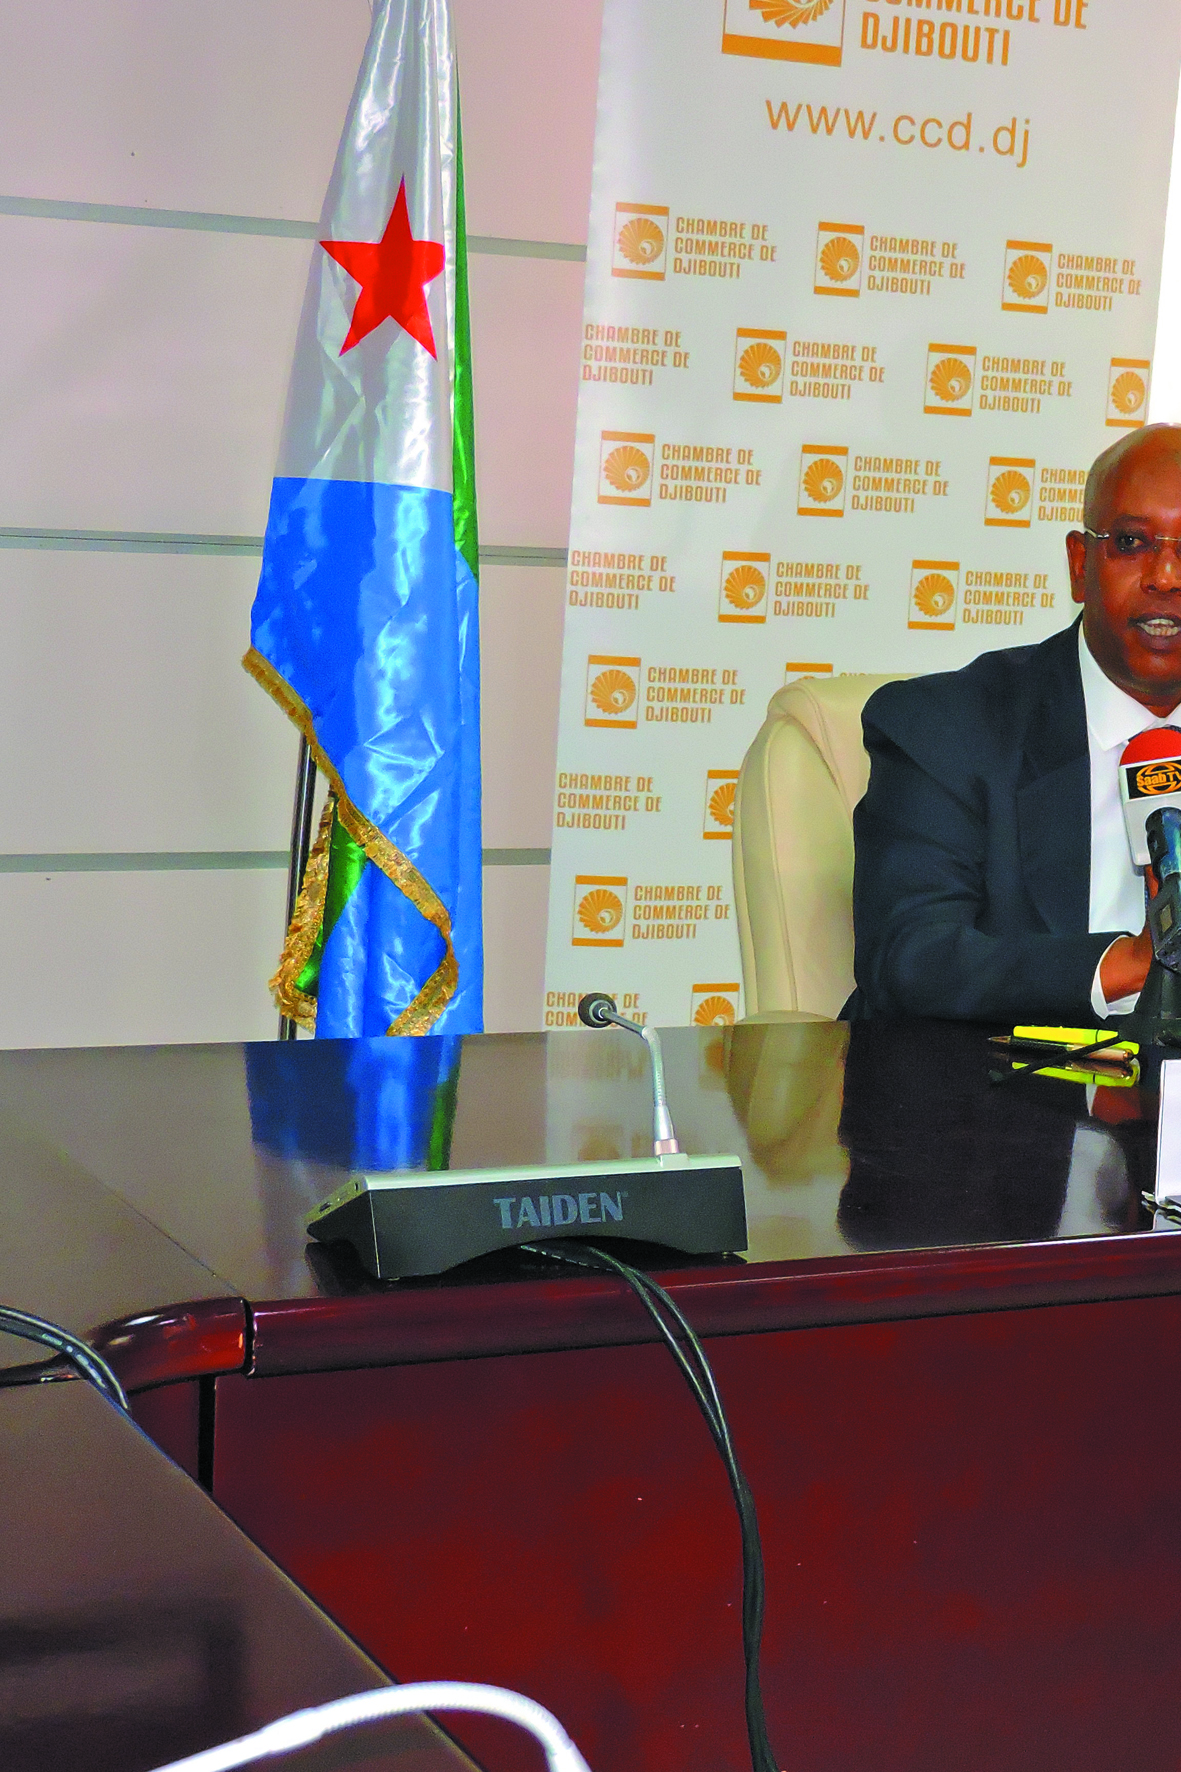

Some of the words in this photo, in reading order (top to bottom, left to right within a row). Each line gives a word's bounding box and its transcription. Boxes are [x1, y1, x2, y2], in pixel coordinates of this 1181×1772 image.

[860, 12, 1010, 66] DJIBOUTI
[765, 98, 1030, 168] www.ccd.dj
[675, 217, 746, 240] CHAMBRE
[751, 224, 767, 240] DE
[674, 236, 753, 259] COMMERCE
[759, 244, 775, 261] DE
[870, 235, 935, 258] CHAMBRE
[941, 242, 956, 257] DE
[673, 254, 740, 277] DJIBOUTI
[868, 254, 944, 277] COMMERCE
[949, 262, 964, 278] DE
[1058, 253, 1117, 274] CHAMBRE
[1122, 259, 1135, 275] DE
[867, 275, 930, 295] DJIBOUTI
[1056, 273, 1123, 293] COMMERCE
[1128, 279, 1140, 294] DE
[1055, 291, 1112, 310] DJIBOUTI
[583, 324, 658, 345] CHAMBRE
[663, 330, 680, 349] DE
[581, 343, 667, 366] COMMERCE
[672, 349, 689, 368] DE
[792, 341, 855, 361] CHAMBRE
[861, 346, 876, 363] DE
[582, 363, 653, 384] DJIBOUTI
[791, 361, 863, 381] COMMERCE
[869, 364, 884, 382] DE
[982, 356, 1045, 375] CHAMBRE
[1051, 361, 1064, 377] DE
[790, 380, 851, 399] DJIBOUTI
[981, 375, 1052, 394] COMMERCE
[1058, 381, 1071, 396] DE
[980, 394, 1040, 412] DJIBOUTI
[662, 443, 731, 463] CHAMBRE
[737, 449, 753, 465] DE
[660, 463, 740, 484] COMMERCE
[745, 469, 761, 485] DE
[854, 456, 919, 474] CHAMBRE
[925, 461, 940, 476] DE
[1041, 467, 1088, 485] CHAMB
[659, 482, 726, 502] DJIBOUTI
[853, 475, 927, 494] COMMERCE
[932, 480, 947, 495] DE
[1039, 486, 1084, 503] COMME
[852, 494, 914, 512] DJIBOUTI
[1038, 505, 1084, 522] DJIBOU
[571, 550, 644, 570] CHAMBRE
[650, 555, 666, 571] DE
[569, 570, 653, 590] COMMERCE
[659, 575, 674, 592] DE
[776, 562, 840, 579] CHAMBRE
[846, 564, 861, 580] DE
[965, 570, 1027, 588] CHAMBRE
[1033, 574, 1048, 589] DE
[569, 590, 639, 608] DJIBOUTI
[775, 580, 848, 599] COMMERCE
[853, 584, 868, 599] DE
[964, 589, 1035, 607] COMMERCE
[1041, 593, 1054, 607] DE
[773, 600, 835, 617] DJIBOUTI
[963, 608, 1024, 624] DJIBOUTI
[647, 666, 716, 685] CHAMBRE
[722, 670, 737, 685] DE
[646, 686, 724, 704] COMMERCE
[730, 689, 745, 704] DE
[645, 705, 711, 722] DJIBOUTI
[557, 773, 630, 791] CHAMBRE
[636, 776, 653, 792] DE
[558, 792, 639, 811] COMMERCE
[645, 796, 661, 812] DE
[555, 812, 625, 829] DJIBOUTI
[633, 885, 702, 902] CHAMBRE
[707, 886, 723, 902] DE
[633, 904, 708, 920] COMMERCE
[714, 904, 729, 919] DE
[632, 923, 696, 939] DJIBOUTI
[623, 993, 640, 1008] DE
[493, 1191, 624, 1229] TAIDEN
